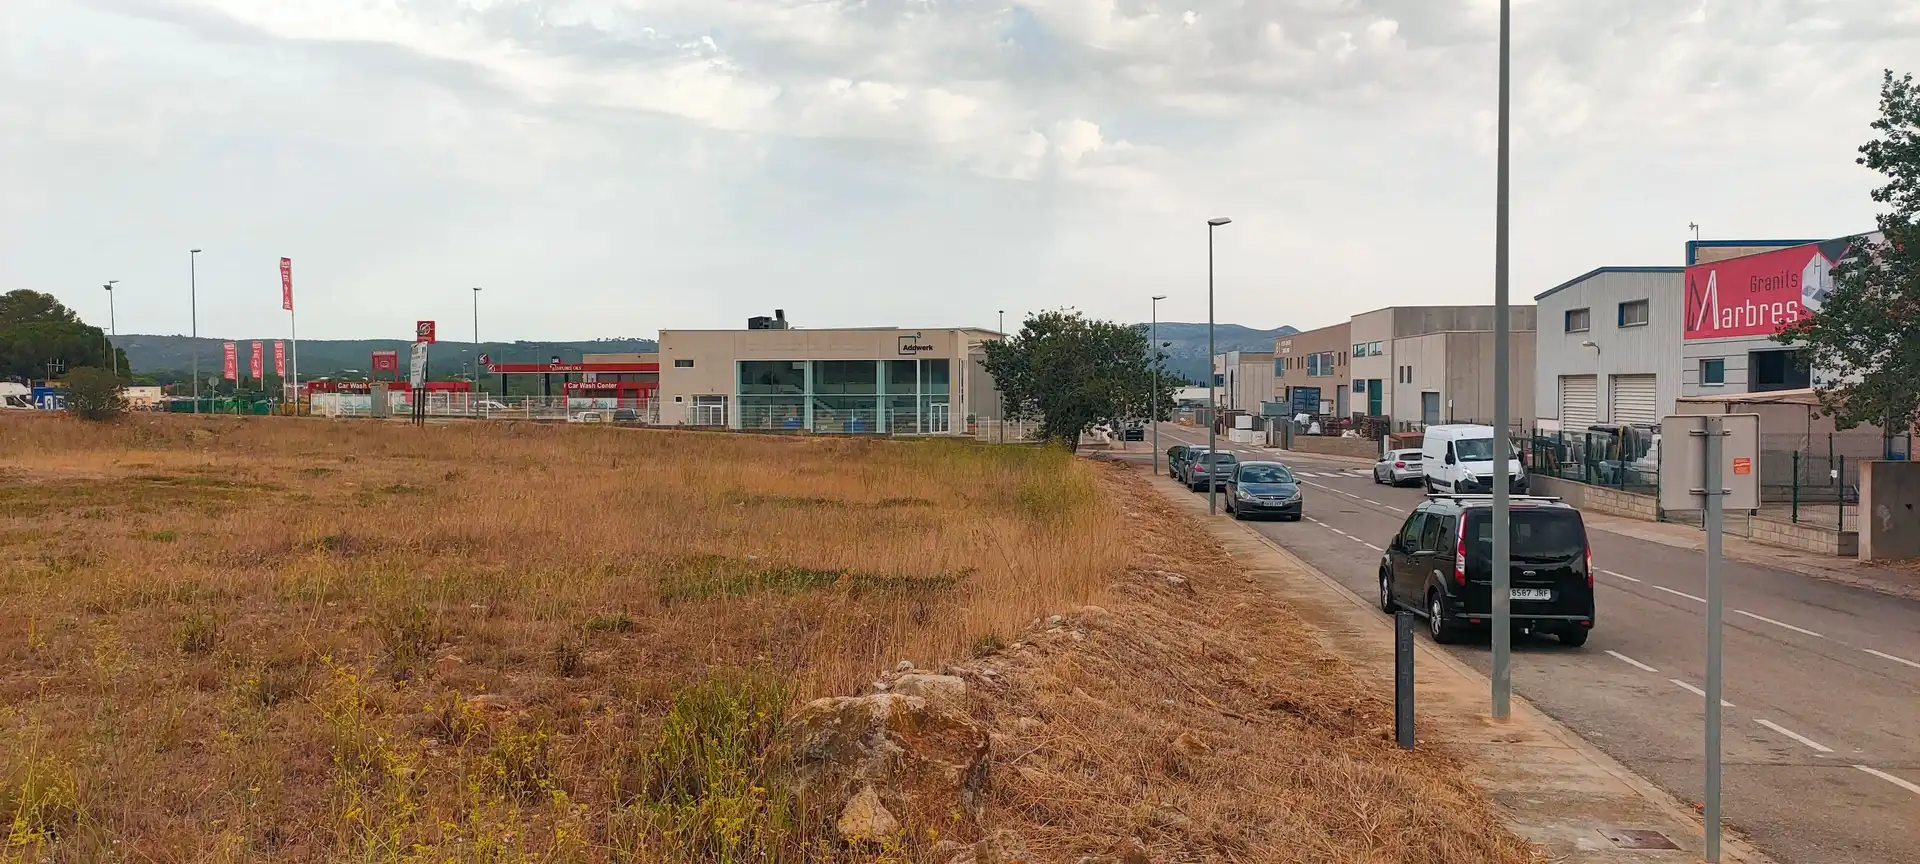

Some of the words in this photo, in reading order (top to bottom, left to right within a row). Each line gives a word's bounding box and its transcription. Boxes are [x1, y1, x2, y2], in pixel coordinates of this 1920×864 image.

[1750, 271, 1799, 293] Granits
[1687, 269, 1799, 332] Marbres
[1511, 589, 1532, 597] 8587
[1534, 589, 1549, 597] JRF
